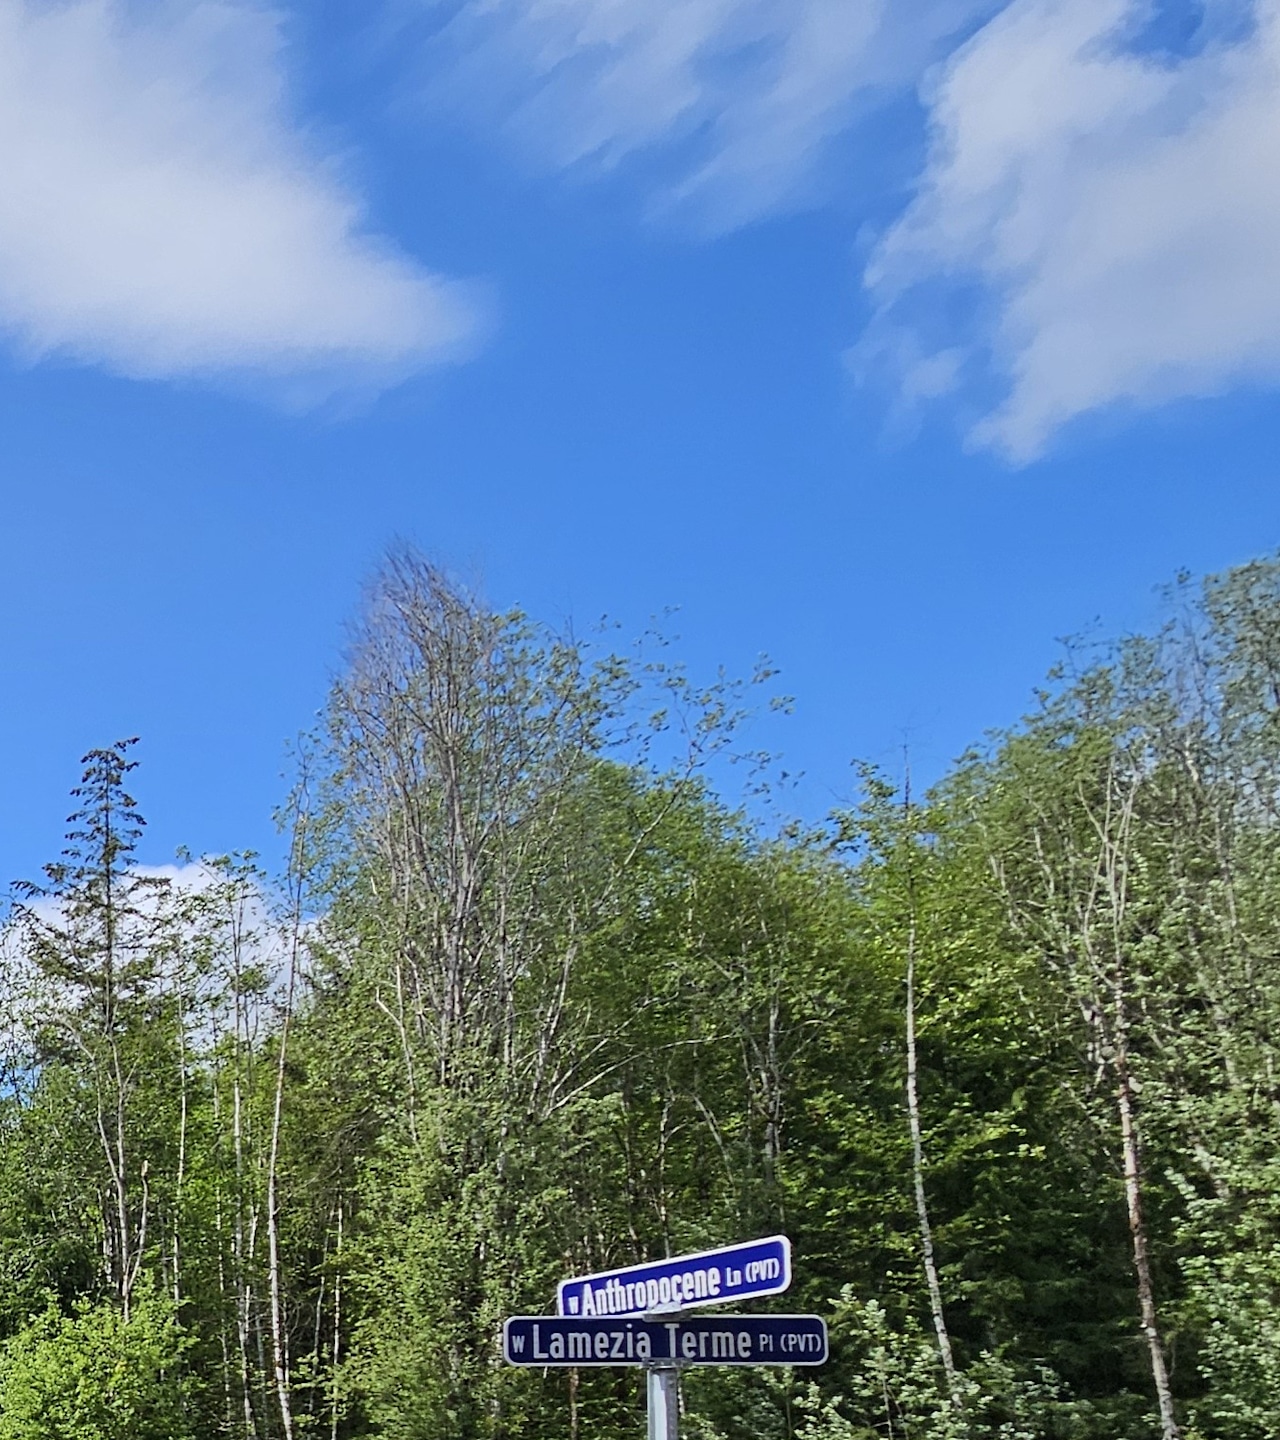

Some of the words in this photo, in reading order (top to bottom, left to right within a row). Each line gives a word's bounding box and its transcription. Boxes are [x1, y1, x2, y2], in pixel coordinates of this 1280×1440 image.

[582, 1267, 721, 1316] Anthropocene
[725, 1267, 742, 1287] Ln
[745, 1257, 780, 1283] (PVT)
[512, 1335, 525, 1353] W
[533, 1324, 651, 1359] Lamezia
[664, 1323, 752, 1358] Terme
[780, 1334, 822, 1352] (PVT)
